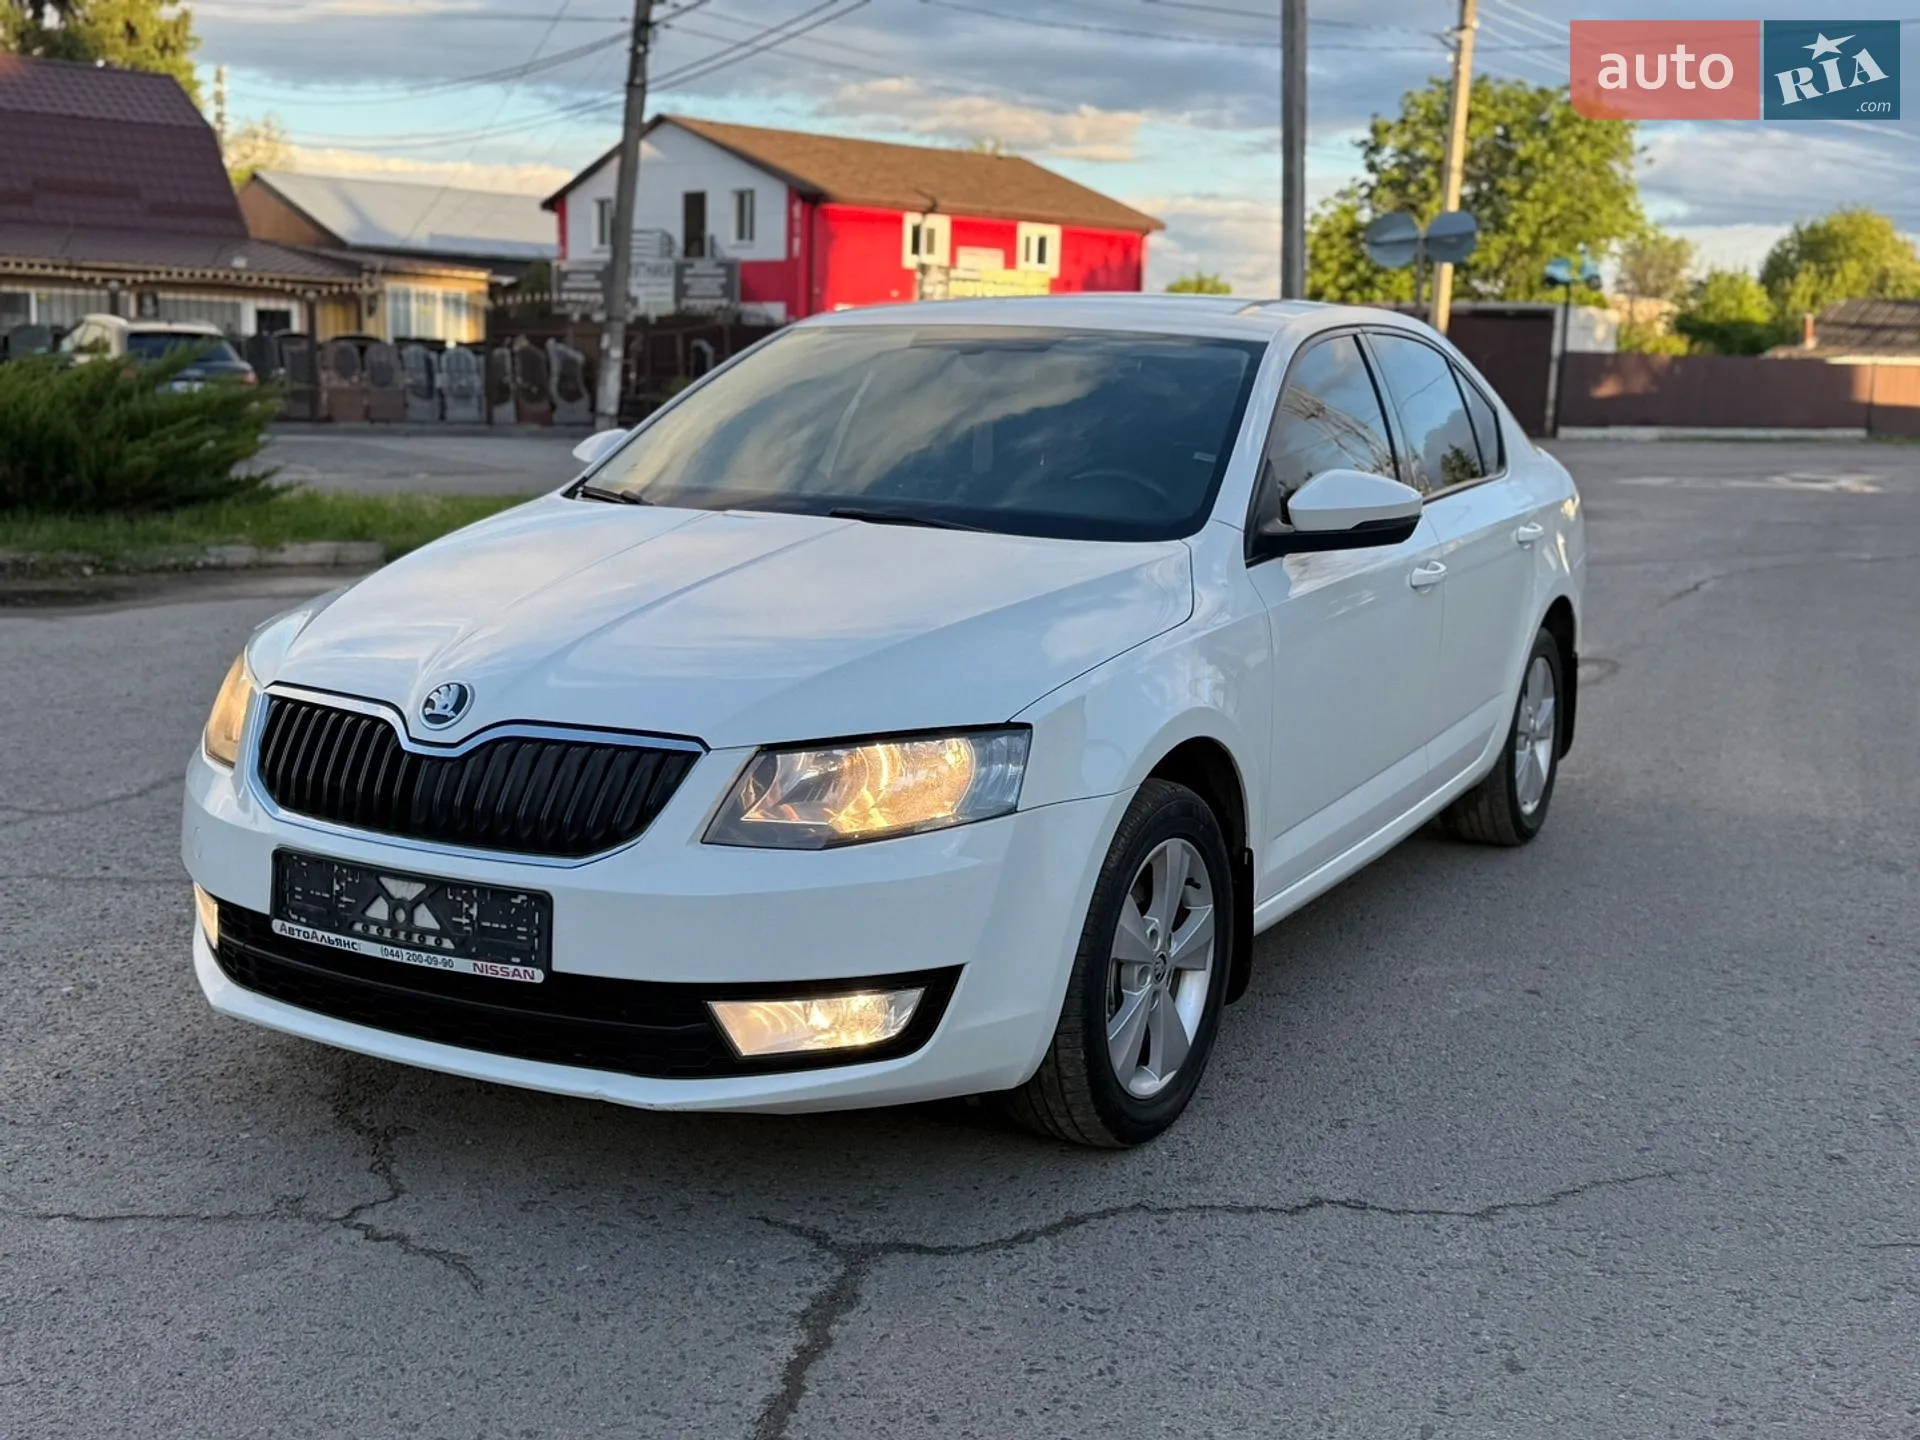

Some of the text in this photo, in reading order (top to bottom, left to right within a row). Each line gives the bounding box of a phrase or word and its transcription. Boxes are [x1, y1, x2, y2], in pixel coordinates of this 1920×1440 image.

[380, 946, 455, 969] (044) 200-09-90
[472, 961, 535, 980] NISSAN
